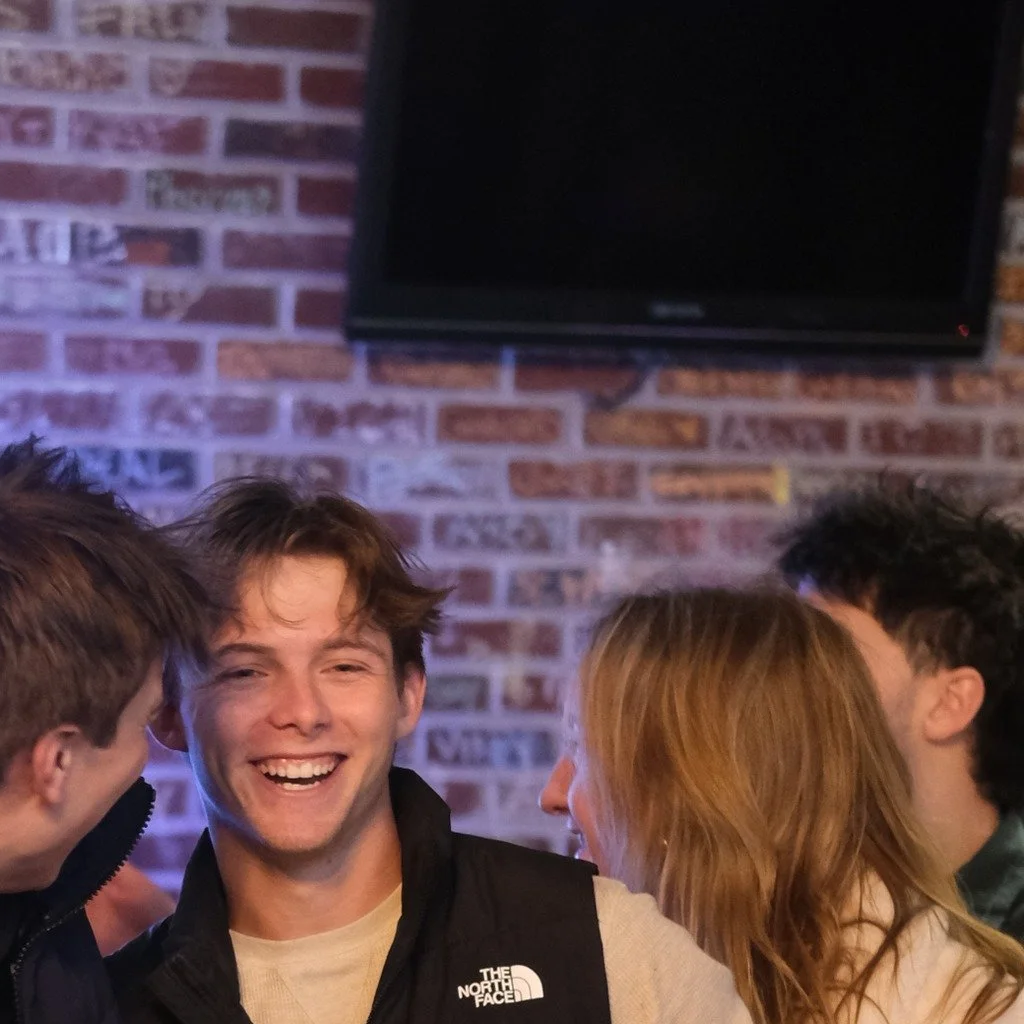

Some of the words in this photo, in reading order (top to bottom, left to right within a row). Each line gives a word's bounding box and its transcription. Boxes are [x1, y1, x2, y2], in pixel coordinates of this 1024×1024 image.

[479, 966, 511, 982] THE
[457, 978, 513, 999] NORTH
[475, 990, 515, 1008] FACE
